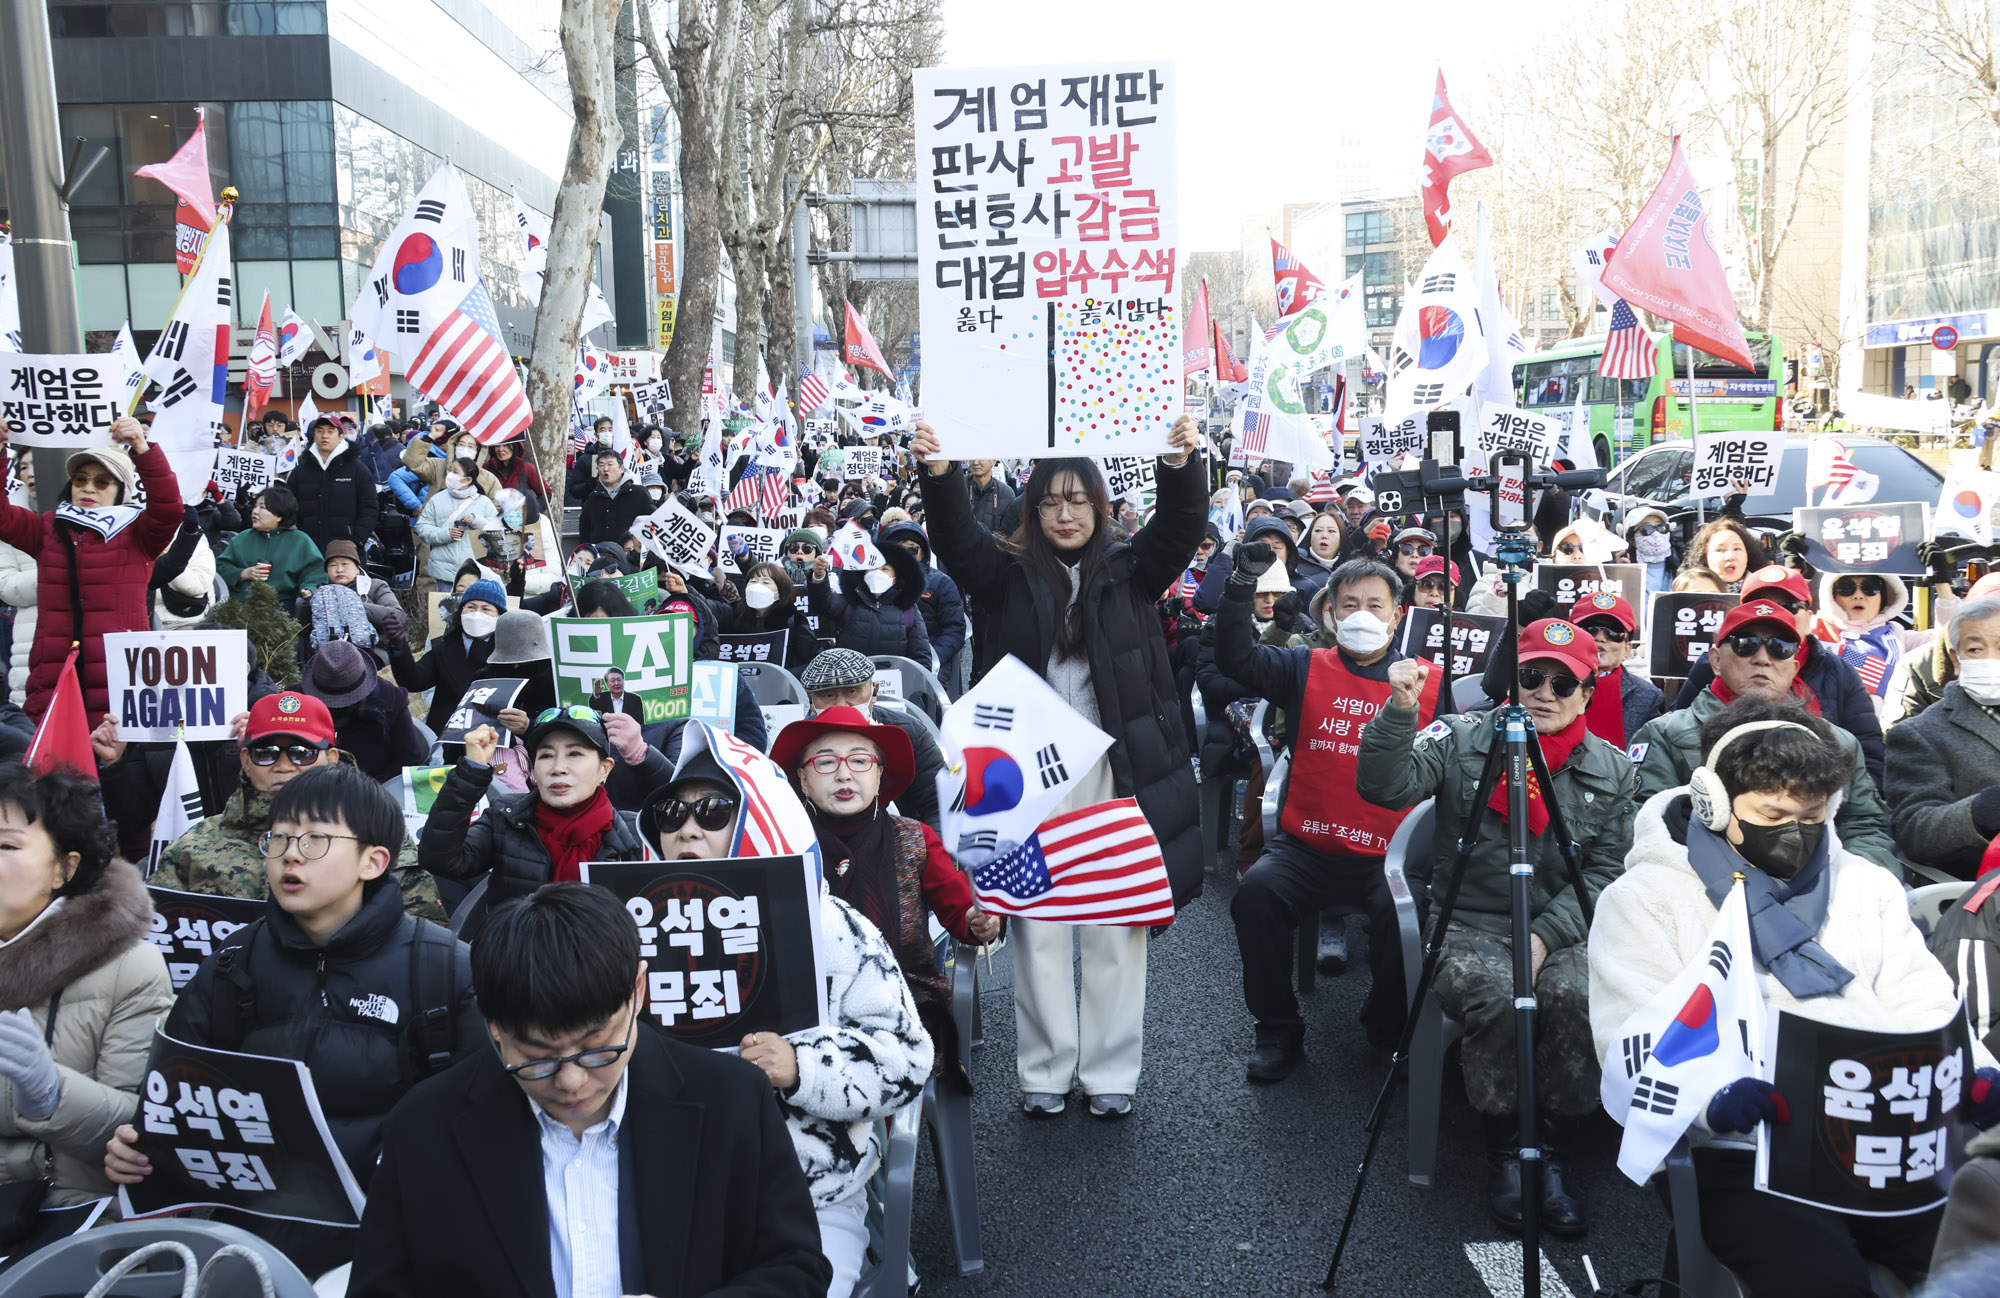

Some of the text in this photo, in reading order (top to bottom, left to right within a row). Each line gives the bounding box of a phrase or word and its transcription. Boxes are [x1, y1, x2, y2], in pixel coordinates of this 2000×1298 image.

[611, 151, 638, 173] 과
[932, 132, 1139, 193] 판사 고발
[934, 189, 1160, 250] 변호사 감금
[657, 256, 674, 283] 공유
[936, 248, 1175, 300] 대검 압수수색
[957, 305, 1003, 333] 옳다
[10, 367, 103, 400] 계엄은
[3, 401, 122, 435] 정당했다
[1492, 413, 1546, 441] 계엄은
[852, 451, 878, 462] 계엄은
[1366, 434, 1424, 455] 정당했다
[1707, 440, 1768, 463] 계엄은
[227, 455, 265, 474] 계엄은
[220, 469, 271, 488] 정당했다
[1696, 465, 1774, 490] 정당했다
[664, 513, 707, 553] 계엄은
[762, 514, 797, 529] YOON
[1822, 516, 1901, 540] 윤석열
[737, 533, 773, 551] 엄은
[1837, 541, 1889, 564] 무죄
[556, 618, 689, 694] 무죄
[719, 643, 771, 661] 윤석열
[124, 646, 217, 686] YOON
[122, 687, 225, 728] AGAIN
[644, 698, 687, 722] Yoon
[1332, 696, 1380, 717] 석열이
[1318, 717, 1351, 736] 사랑
[1309, 739, 1336, 752] 끝까지
[1301, 819, 1330, 835] 유튜브
[625, 896, 760, 957] 윤석열
[349, 997, 385, 1012] NORTH
[368, 993, 387, 1003] THE
[648, 969, 741, 1026] 무죄
[357, 1007, 382, 1019] FACE
[1824, 1046, 1964, 1123] 윤석열
[143, 1070, 275, 1144] 윤석열
[174, 1147, 277, 1191] 무죄
[1854, 1126, 1948, 1189] 무죄
